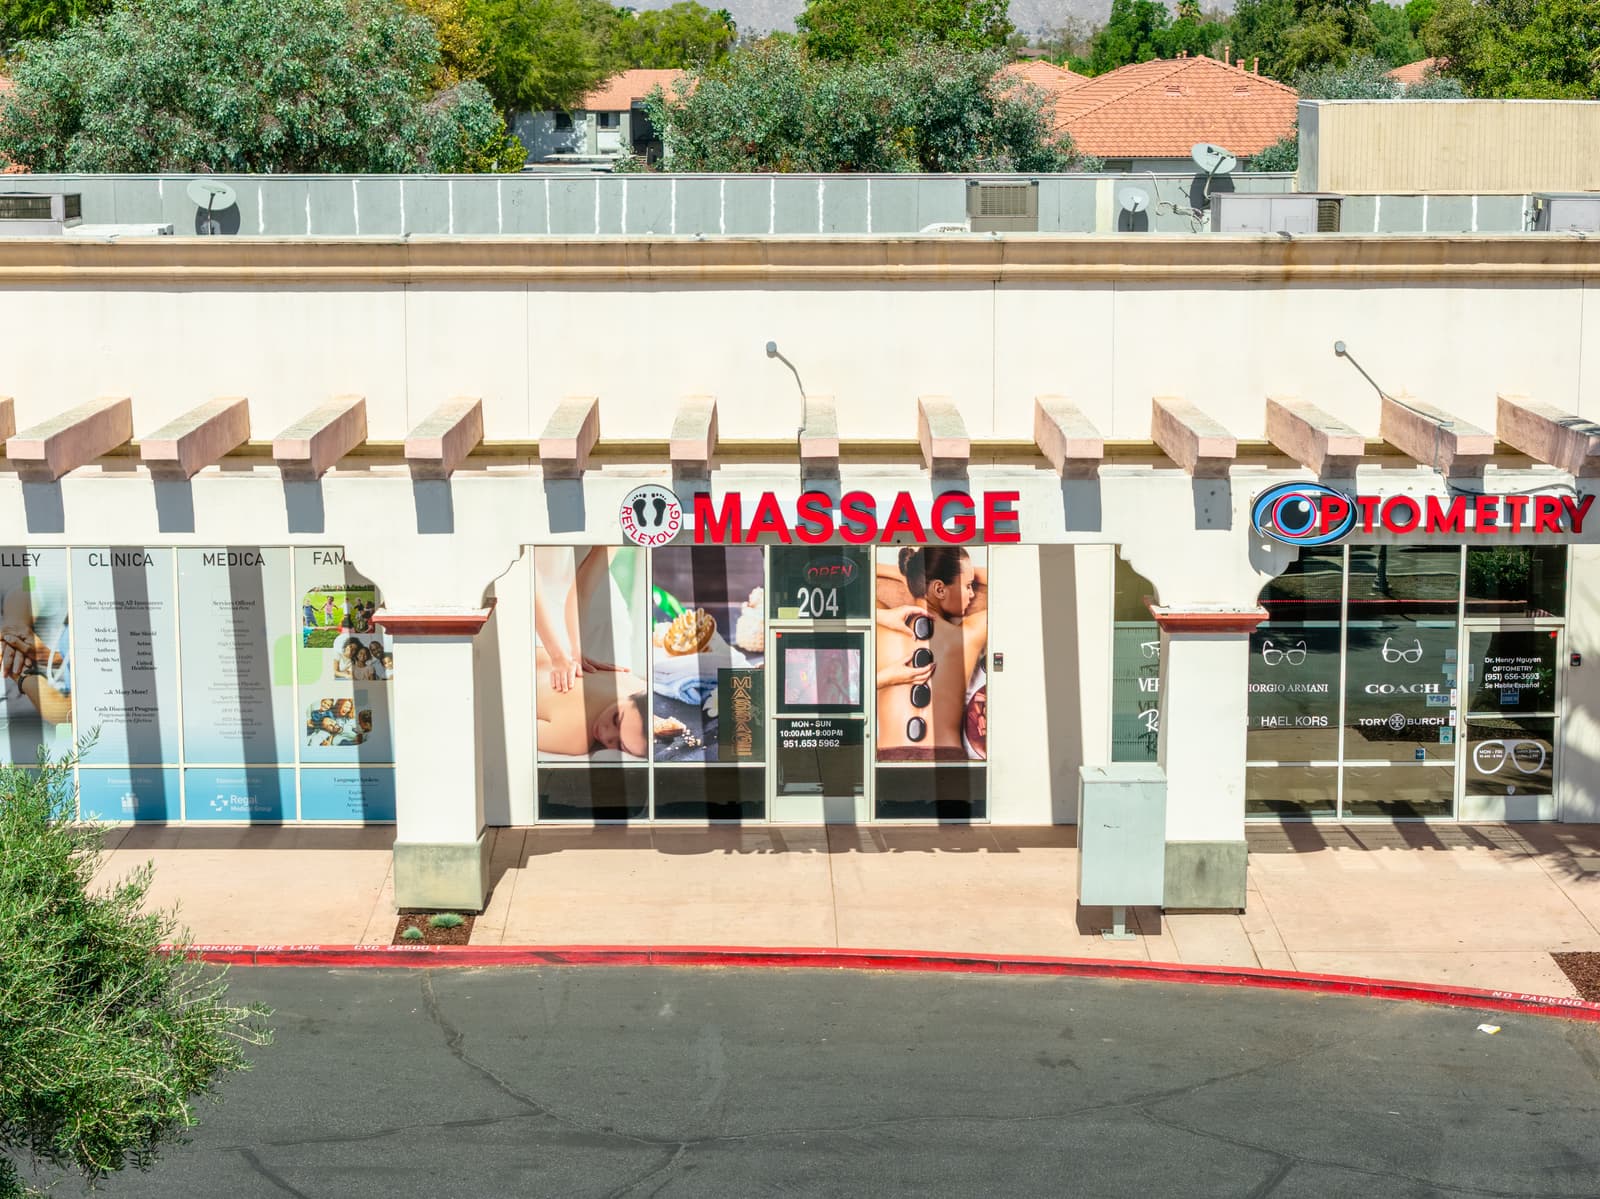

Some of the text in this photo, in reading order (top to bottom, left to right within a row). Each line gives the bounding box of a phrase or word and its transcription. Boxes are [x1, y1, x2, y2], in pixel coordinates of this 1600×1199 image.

[693, 490, 1022, 544] MASSAGE
[620, 502, 681, 545] REFLEXOLOGY
[1, 552, 41, 567] LLEY
[88, 552, 154, 567] CLINICA
[203, 552, 266, 567] MEDICA
[313, 551, 352, 566] FAM
[797, 587, 839, 617] 204
[1495, 656, 1515, 664] Henry
[1516, 656, 1542, 664] Nguyen
[1484, 672, 1540, 682] (951) 656-3693
[1287, 683, 1329, 693] ARMANI
[1364, 683, 1440, 694] COACH
[1428, 695, 1449, 704] vsp
[791, 720, 810, 728] MON
[815, 720, 832, 728] SUN
[1295, 715, 1329, 727] KORS
[1359, 718, 1388, 726] TORY
[1407, 717, 1445, 726] BURCH
[230, 795, 257, 806] Regal
[1491, 991, 1513, 999] NO
[1520, 994, 1583, 1007] PARKING
